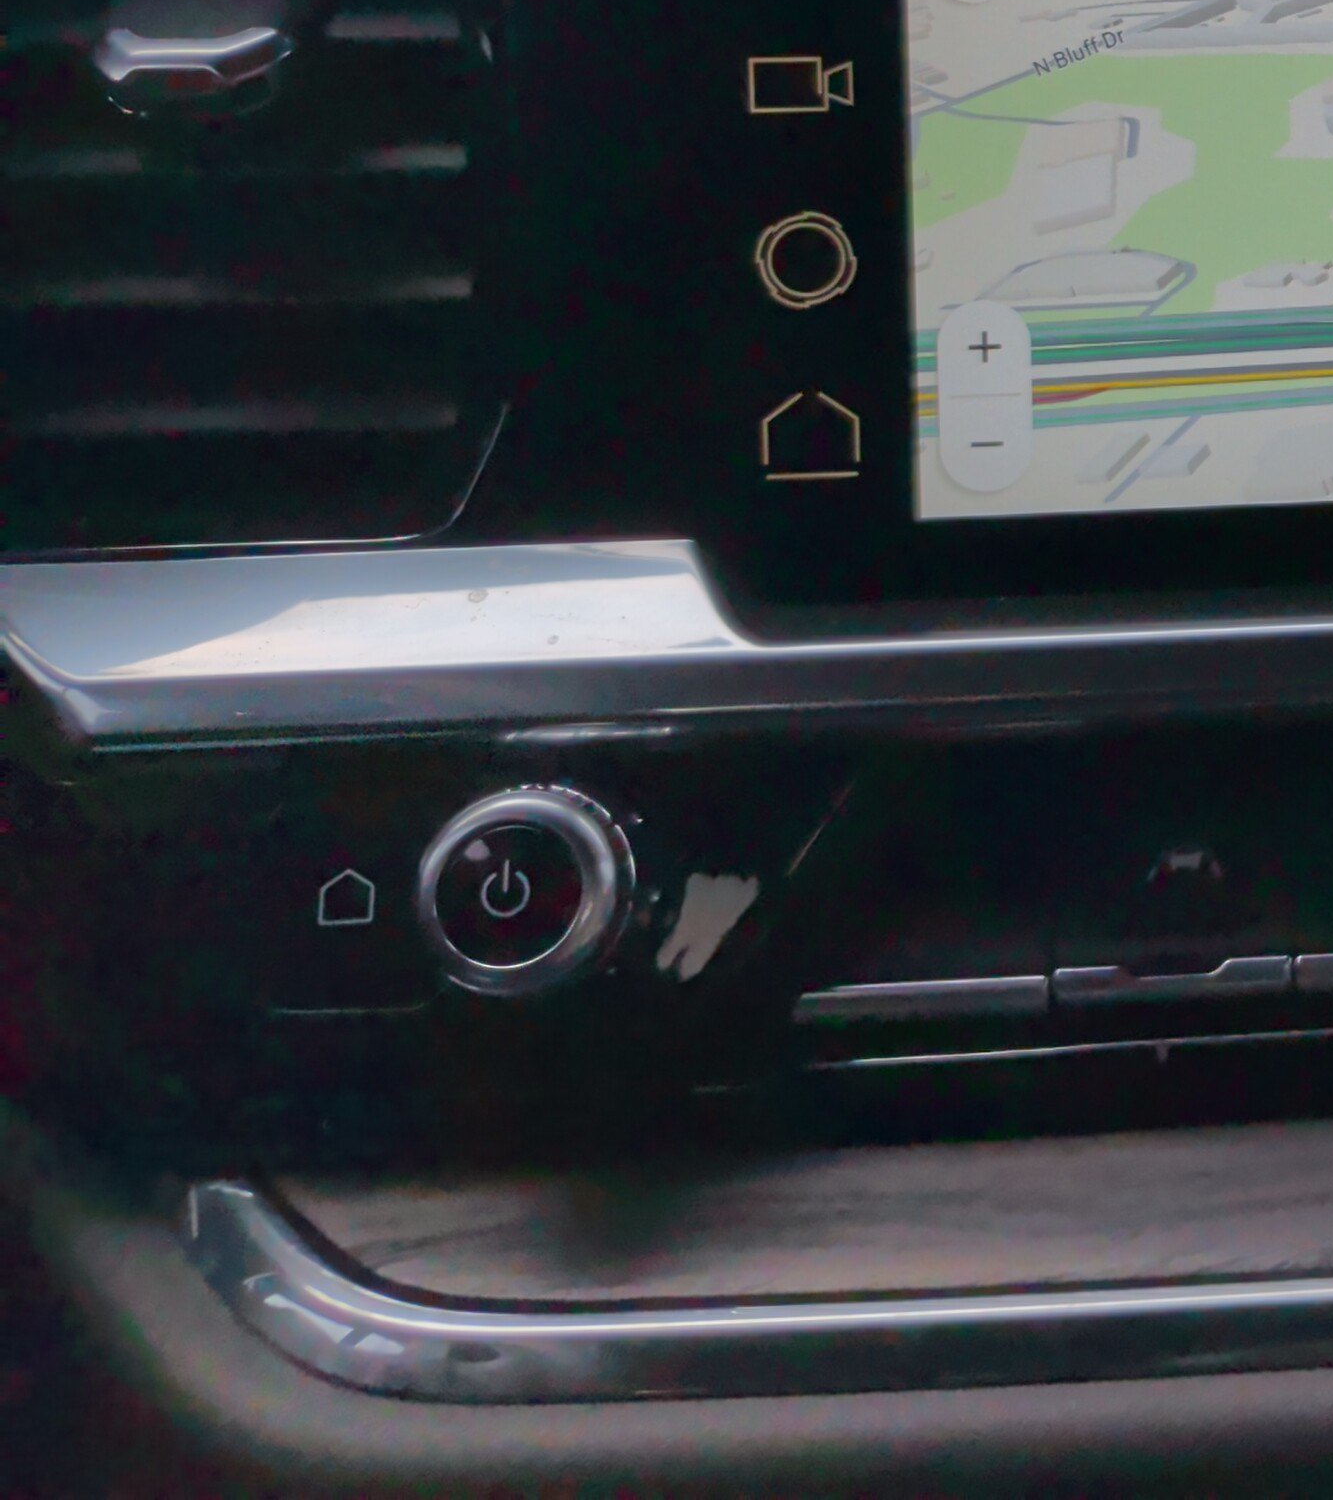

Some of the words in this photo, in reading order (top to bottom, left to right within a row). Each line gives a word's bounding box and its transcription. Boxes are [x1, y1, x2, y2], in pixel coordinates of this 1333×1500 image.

[1032, 57, 1051, 76] N
[1052, 36, 1099, 69] Bluff
[1101, 30, 1124, 49] Dr
